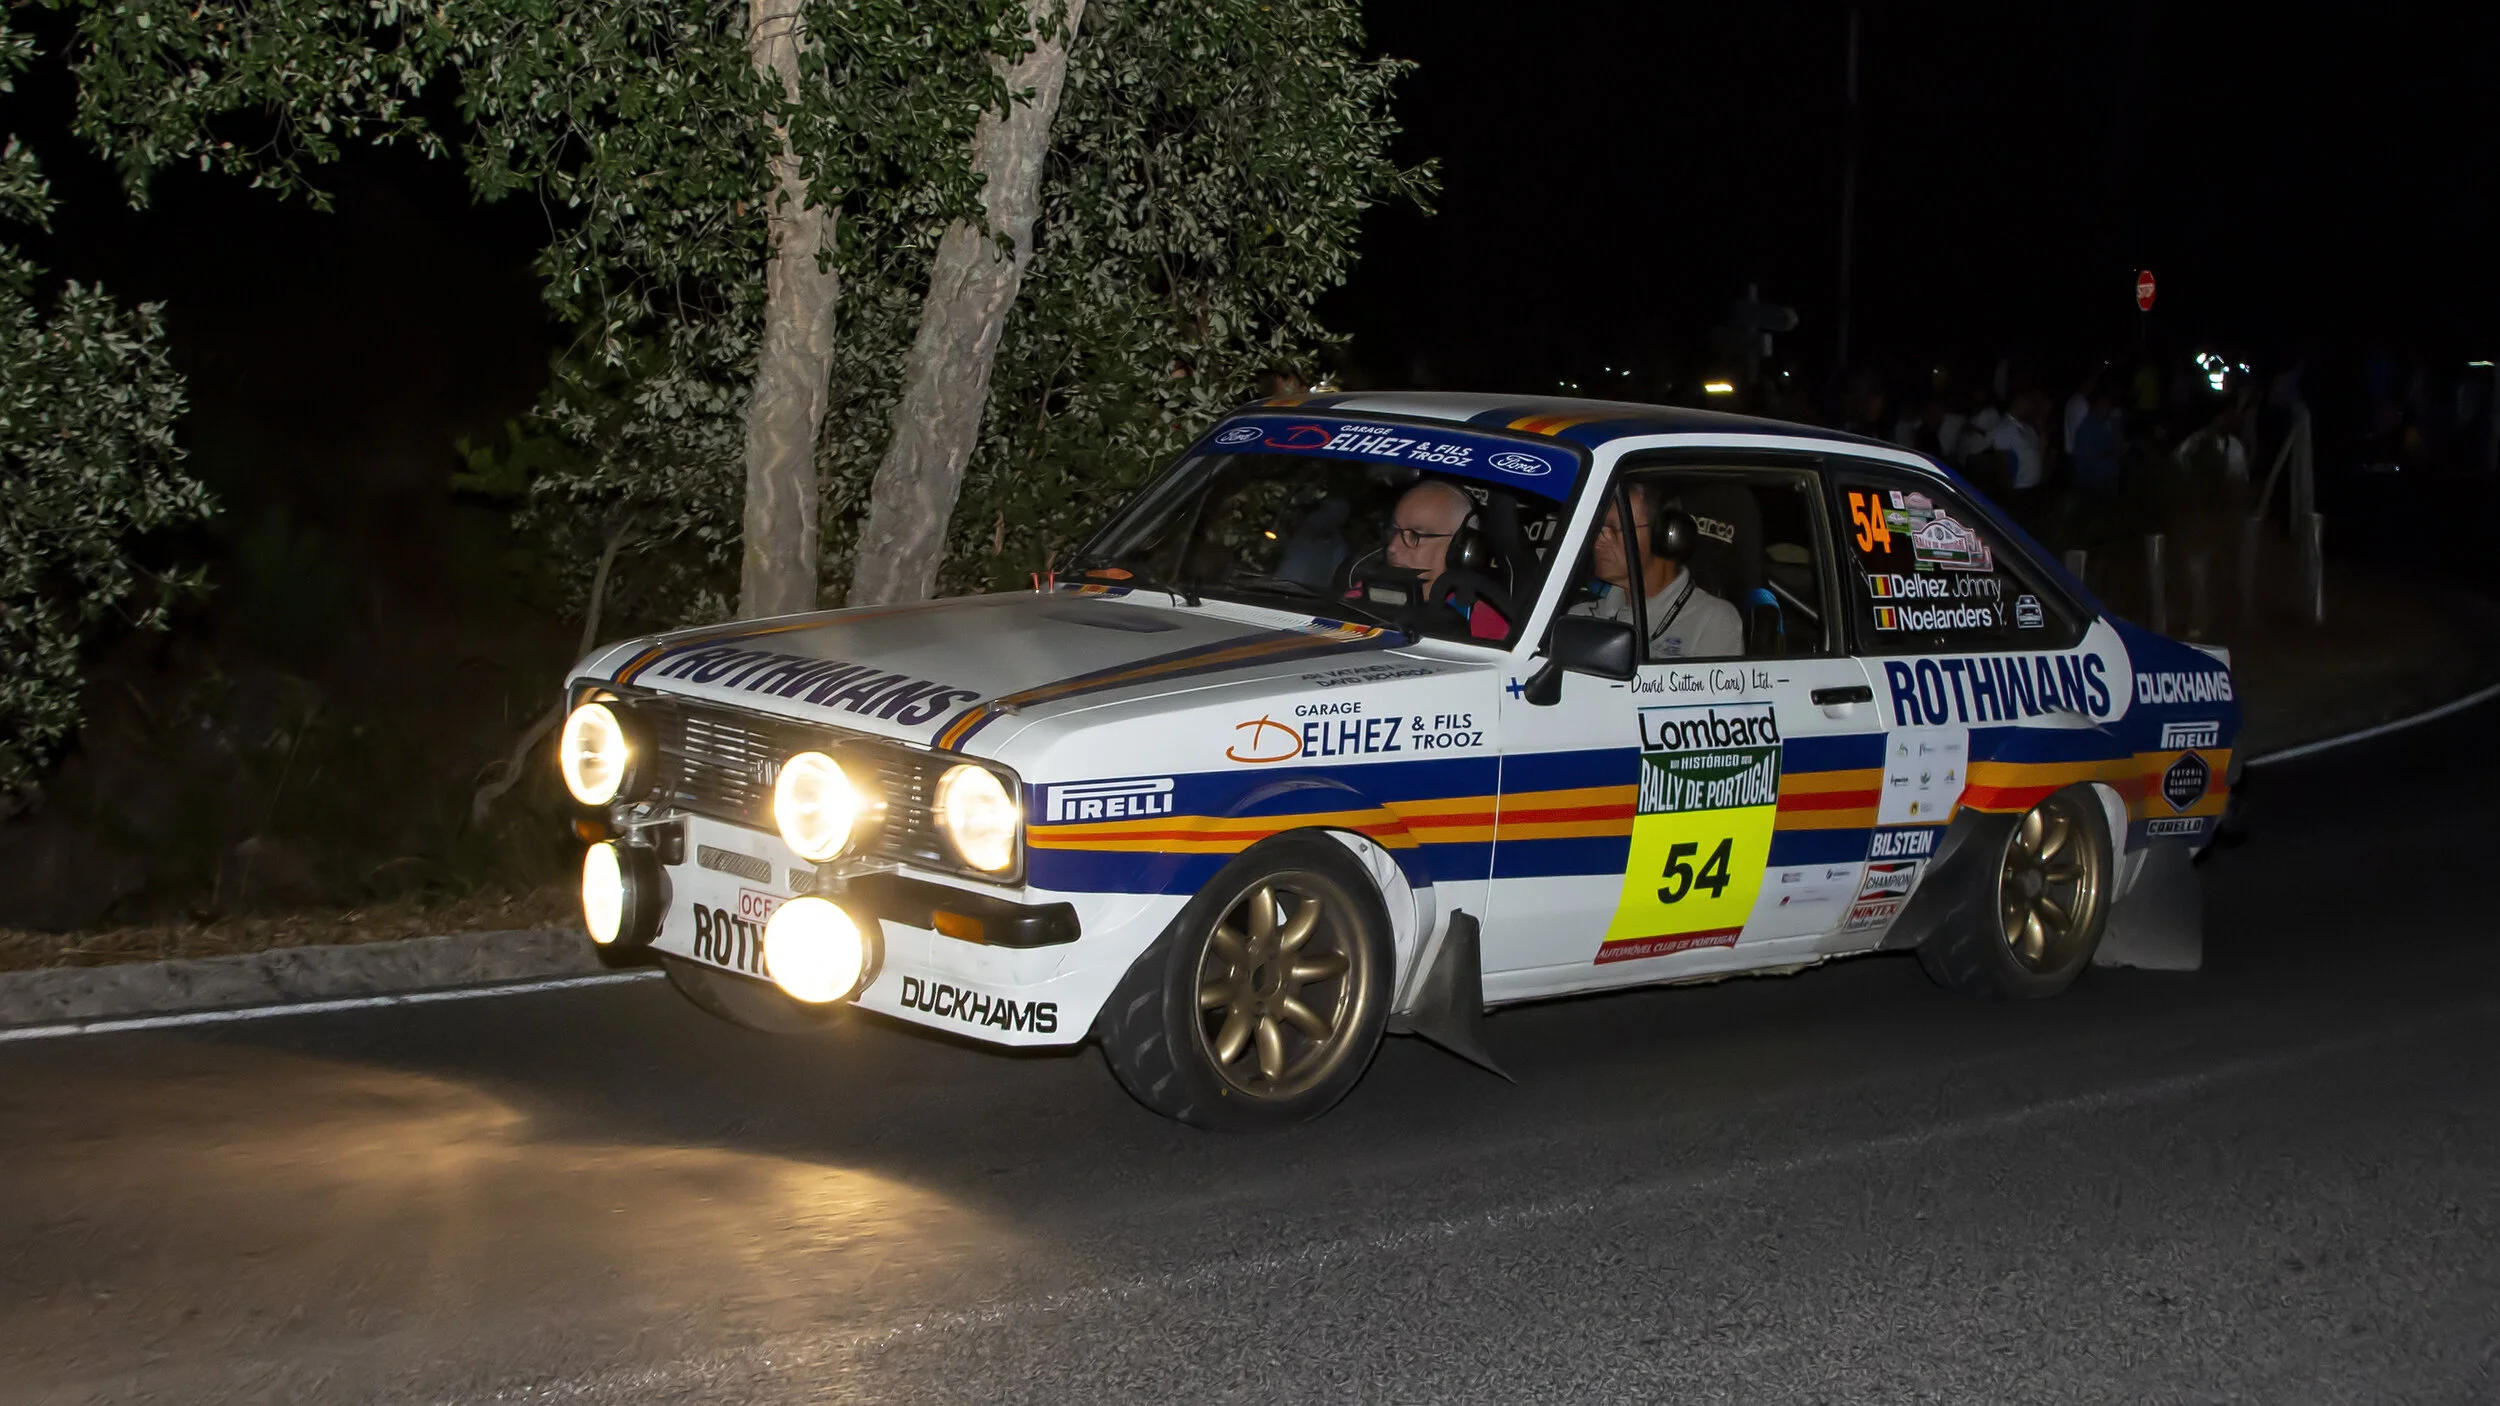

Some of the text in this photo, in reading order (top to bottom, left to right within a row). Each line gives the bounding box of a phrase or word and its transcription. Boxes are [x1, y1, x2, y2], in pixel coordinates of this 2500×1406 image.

[1340, 424, 1394, 435] GARAGE
[1407, 449, 1475, 467] TROOZ
[1416, 441, 1473, 457] & FILS
[1497, 453, 1543, 475] Ford
[1849, 492, 1891, 553] 54
[1891, 573, 2001, 602] Delhez Johnny
[1898, 603, 1992, 631] Noelanders
[1316, 668, 1433, 687] DAVID RICHARDS
[1631, 668, 1773, 694] David Sutton (Cars) Ltd.
[2135, 671, 2234, 704] DUCKHAMS
[1295, 702, 1362, 717] GARAGE
[1411, 713, 1472, 731] & FILS
[1226, 714, 1402, 763] DELHEZ
[1412, 731, 1483, 750] TROOZ
[1639, 706, 1780, 751] Lombard
[2160, 720, 2220, 749] PIRELLI
[1681, 754, 1739, 771] HISTÓRICO
[1638, 750, 1777, 813] RALLY DE PORTUGAL
[1047, 778, 1174, 821] PIRELLI
[2149, 820, 2203, 834] CARELLO
[1871, 830, 1934, 857] BILSTEIN
[1657, 838, 1734, 904] 54
[1867, 873, 1911, 889] CHAMPION
[1852, 904, 1896, 919] MINTEX
[693, 902, 770, 978] ROTH
[1690, 933, 1737, 949] PORTUGAL
[900, 975, 1058, 1034] DUCKHAMS
